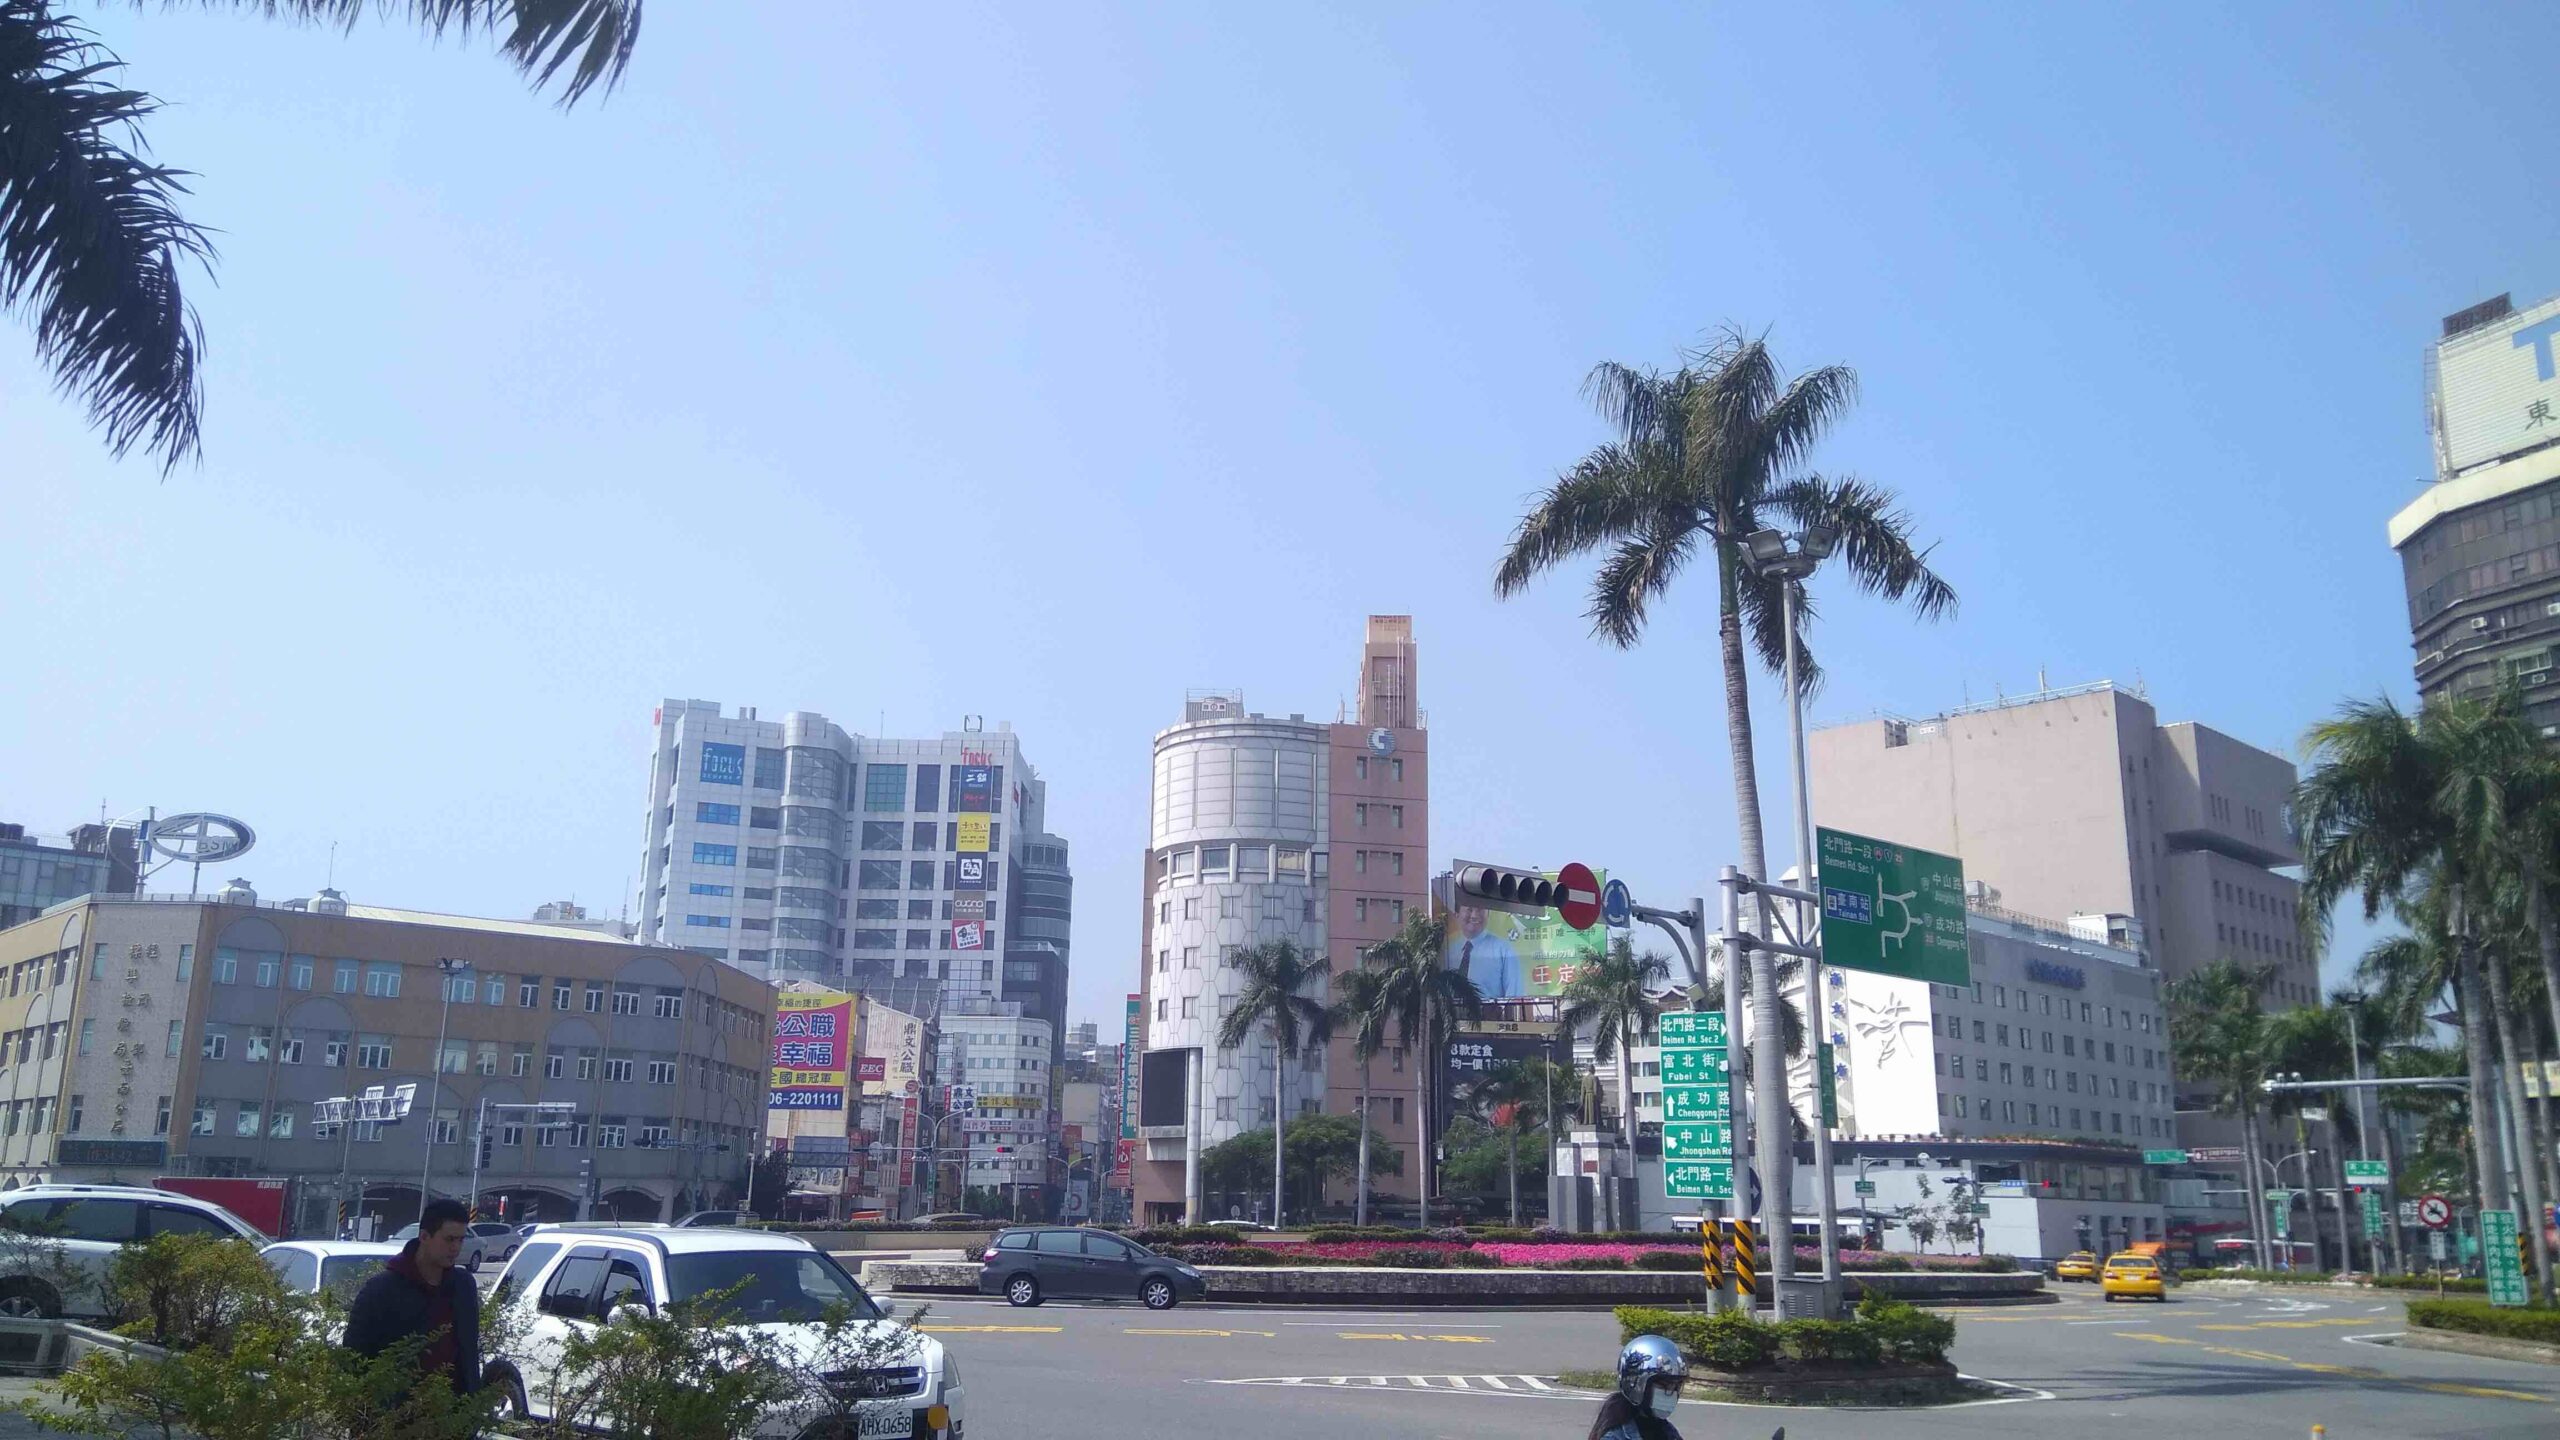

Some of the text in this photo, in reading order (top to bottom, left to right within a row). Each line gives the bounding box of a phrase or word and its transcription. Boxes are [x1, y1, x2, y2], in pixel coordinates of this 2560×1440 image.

[2525, 399, 2557, 431] 東
[962, 747, 992, 769] focus
[1824, 836, 1872, 859] 北門路一段
[1932, 872, 1963, 891] 中山路
[1935, 917, 1965, 934] 成功路
[1662, 1017, 1719, 1032] 北門路二段
[1663, 1035, 1684, 1044] Beimen
[773, 1041, 833, 1066] 幸福
[900, 1023, 917, 1075] 鼎文公職
[1451, 1043, 1493, 1057] 8款定食
[1663, 1053, 1715, 1068] 富北街
[860, 1064, 884, 1073] EEC
[1668, 1072, 1692, 1080] Fubei
[769, 1092, 838, 1105] 06-2201111
[1678, 1091, 1729, 1106] 成功路
[1678, 1109, 1717, 1119] Chenggong
[1680, 1129, 1731, 1144] 中山路
[1680, 1147, 1720, 1157] Jhongshan
[1677, 1185, 1700, 1193] Beimen
